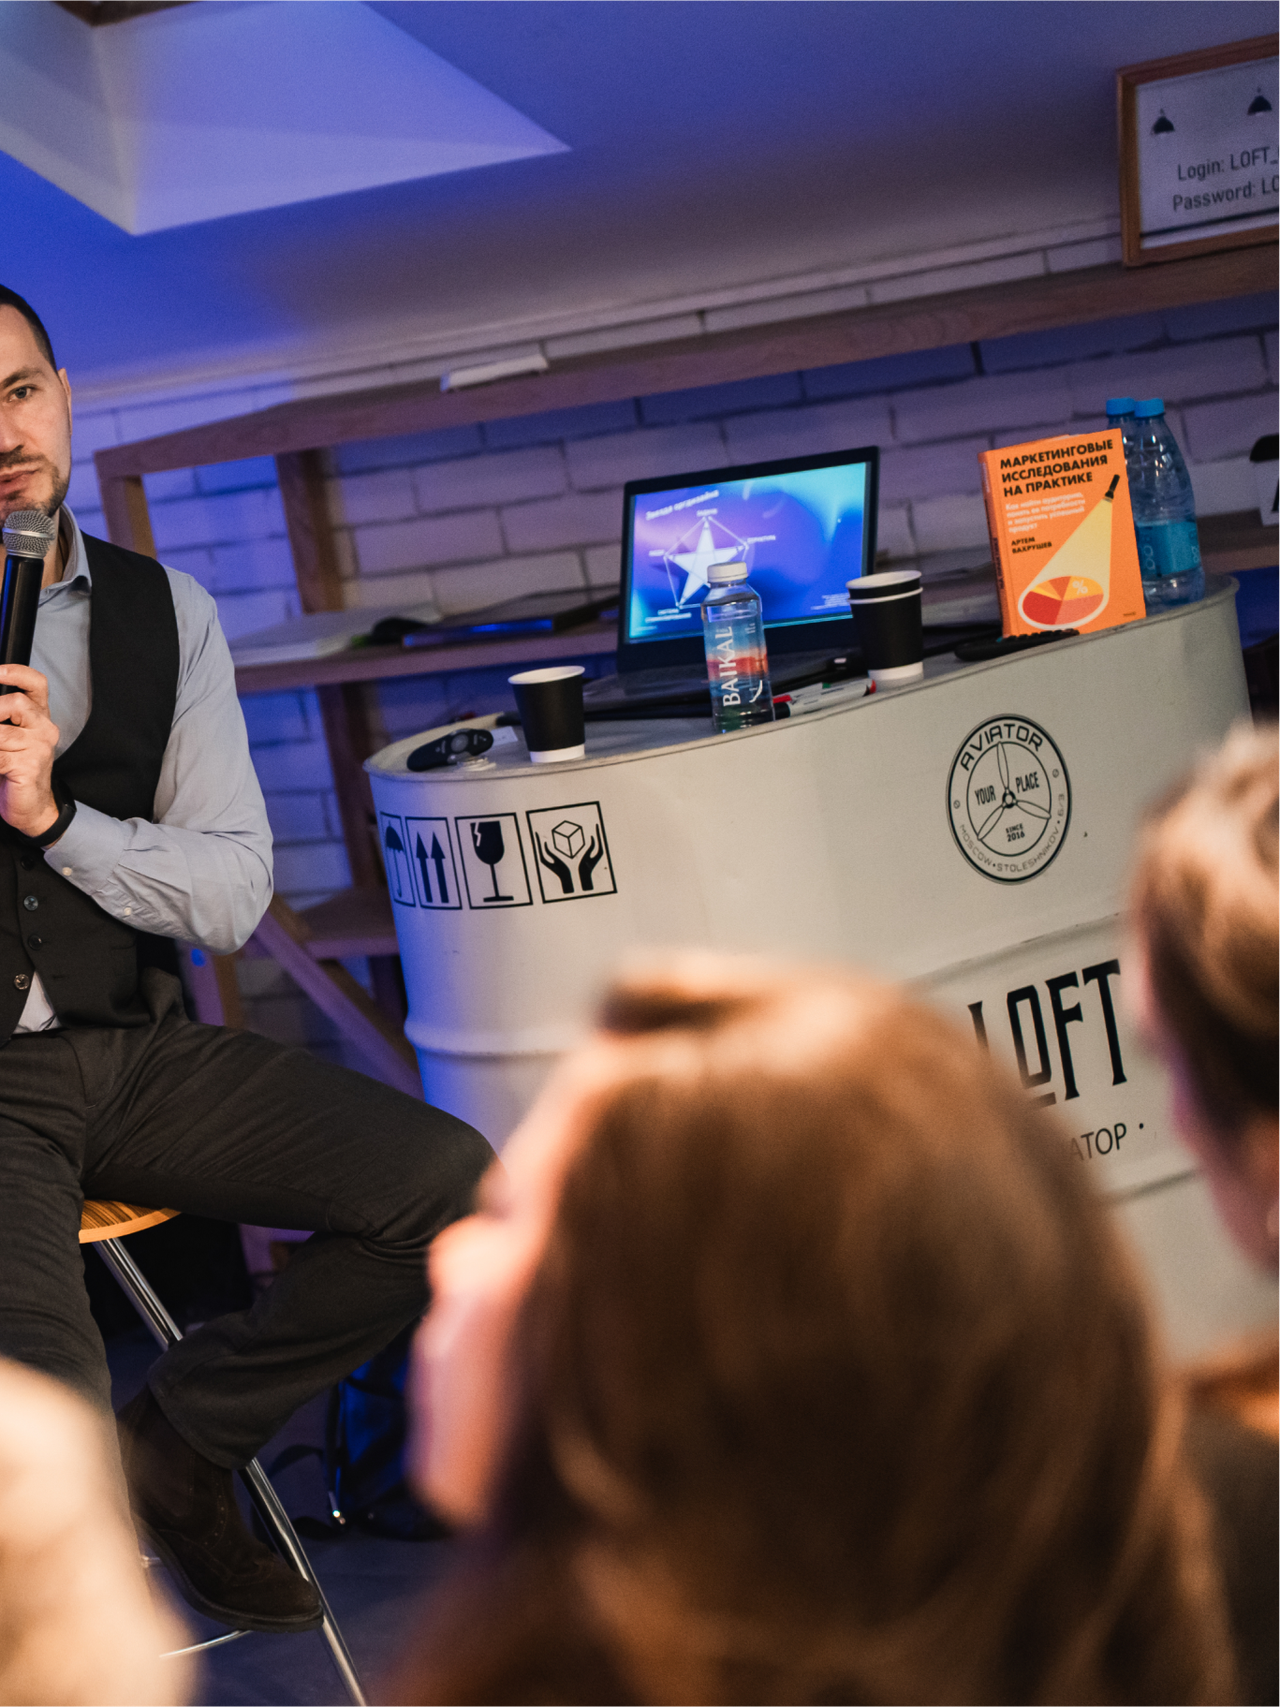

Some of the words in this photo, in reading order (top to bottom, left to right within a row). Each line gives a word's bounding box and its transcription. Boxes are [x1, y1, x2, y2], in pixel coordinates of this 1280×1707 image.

[1177, 159, 1224, 181] Login:
[1230, 145, 1280, 171] LOFT_
[1173, 180, 1255, 212] Password:
[1000, 439, 1113, 469] МАРКЕТИНГОВЫЕ
[1001, 454, 1108, 483] ИССЛЕДОВАНИЯ
[1003, 485, 1023, 497] НА
[1025, 471, 1093, 493] ПРАКТИКЕ
[1011, 536, 1035, 546] АРТЕМ
[1011, 541, 1052, 554] ВАХРУШЕВ
[715, 626, 741, 707] BAIKAL
[960, 723, 1043, 771] AVIATOR
[974, 785, 997, 806] YOUR
[1015, 771, 1040, 794] PLACE
[1005, 823, 1023, 834] SINCE
[960, 824, 992, 866] MOSCOW
[996, 826, 1059, 873] STOLESHNIKOV
